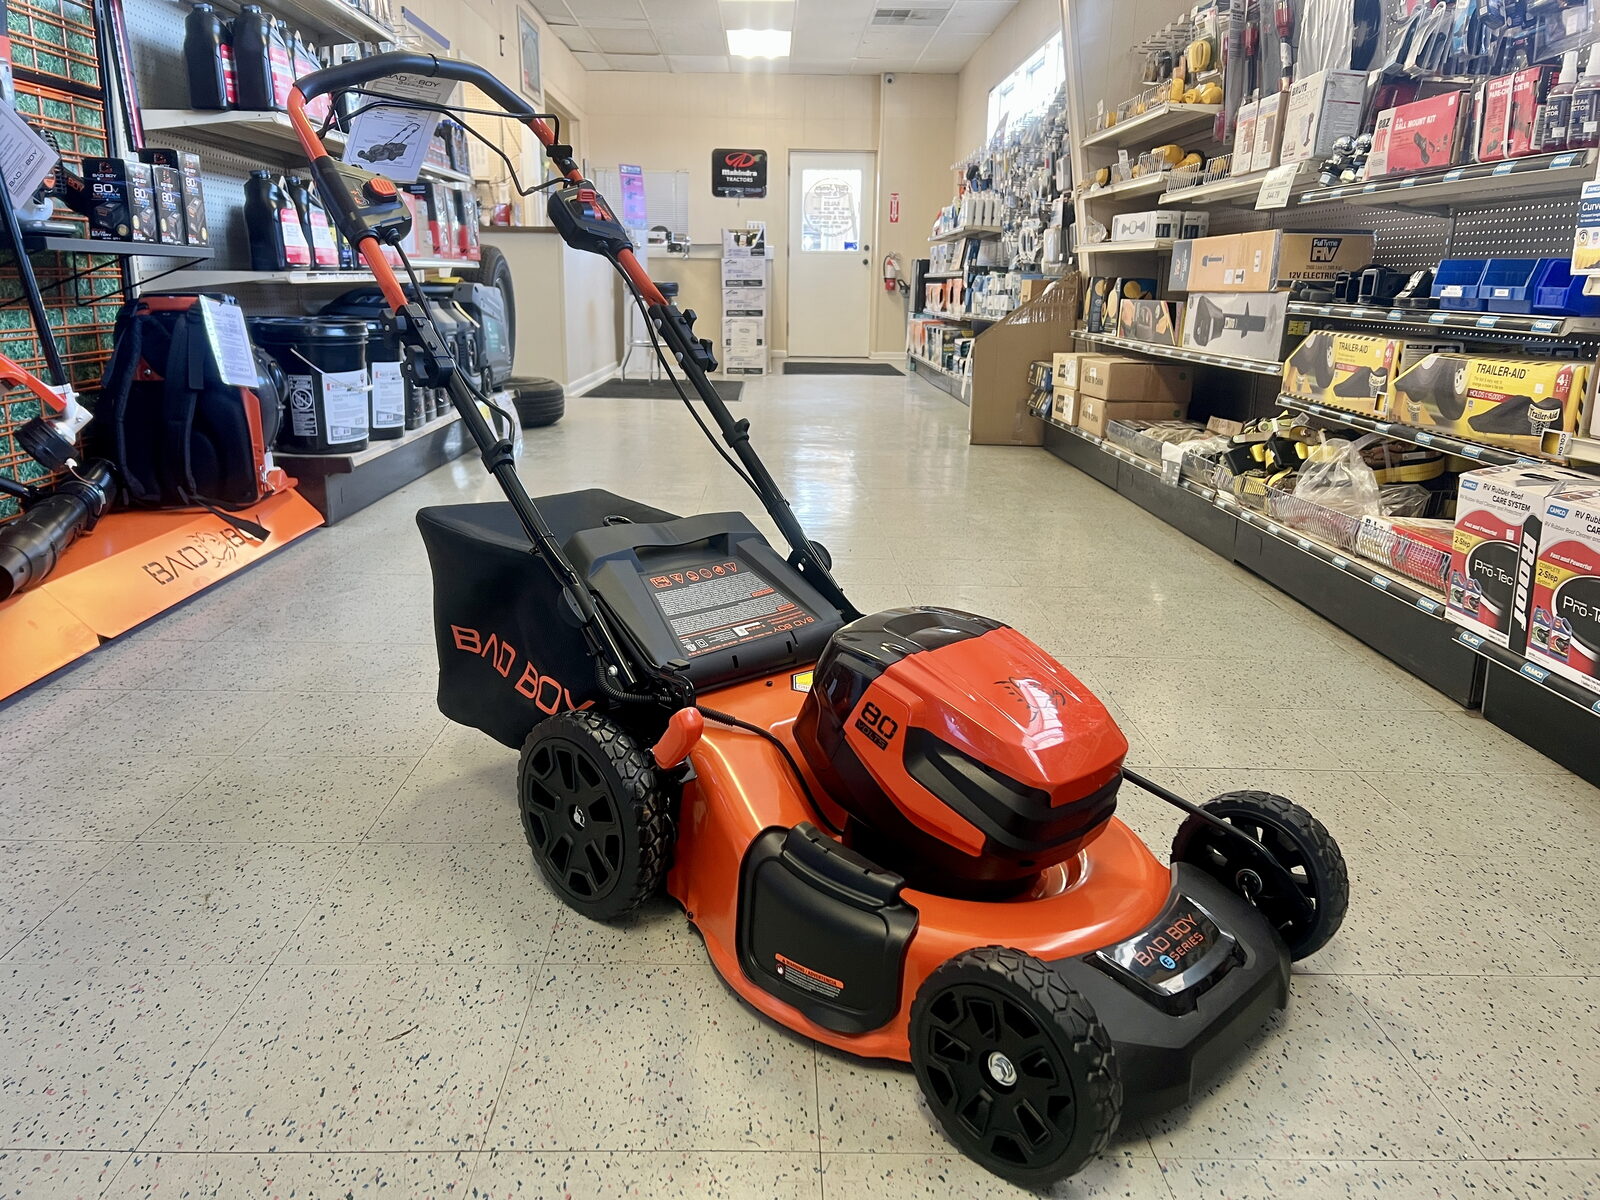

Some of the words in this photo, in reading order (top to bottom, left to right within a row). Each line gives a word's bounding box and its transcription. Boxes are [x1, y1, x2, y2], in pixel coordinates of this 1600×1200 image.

[418, 79, 440, 87] BOY
[1292, 82, 1308, 97] BRUTE
[9, 171, 22, 187] BAD
[26, 150, 38, 166] BOY
[721, 169, 757, 177] Mahindra
[1303, 271, 1337, 280] ELECTRIC
[1339, 342, 1369, 354] TRAILER-AID
[1476, 363, 1527, 379] TRAILER-AID
[1469, 389, 1485, 398] HOLDS
[1529, 407, 1559, 420] Trailer-Aid
[1463, 480, 1477, 489] CAMCO
[1483, 483, 1491, 491] RV
[1491, 485, 1510, 497] Rubber
[1510, 491, 1524, 500] Roof
[1492, 495, 1507, 505] CARE
[1507, 498, 1531, 512] SYSTEM
[1549, 508, 1566, 517] CAMCO
[1575, 510, 1585, 519] RV
[1551, 523, 1565, 531] Rubber
[1576, 531, 1592, 539] Cleaner
[1454, 536, 1470, 548] 2-Step
[141, 546, 208, 585] BAD
[1550, 552, 1560, 560] Fast
[1570, 559, 1592, 571] Powerful
[1474, 559, 1514, 586] Pro-Tec
[1538, 568, 1558, 583] 2-Step
[1514, 531, 1538, 632] Roof
[774, 623, 793, 633] BOY
[793, 616, 815, 628] BAD
[450, 624, 517, 678] BAD
[514, 660, 596, 715] BOY
[861, 701, 899, 740] 80
[856, 719, 888, 750] VOLTS
[1134, 936, 1171, 967] BAD
[1165, 913, 1198, 941] BOY
[1170, 932, 1204, 962] SERIES
